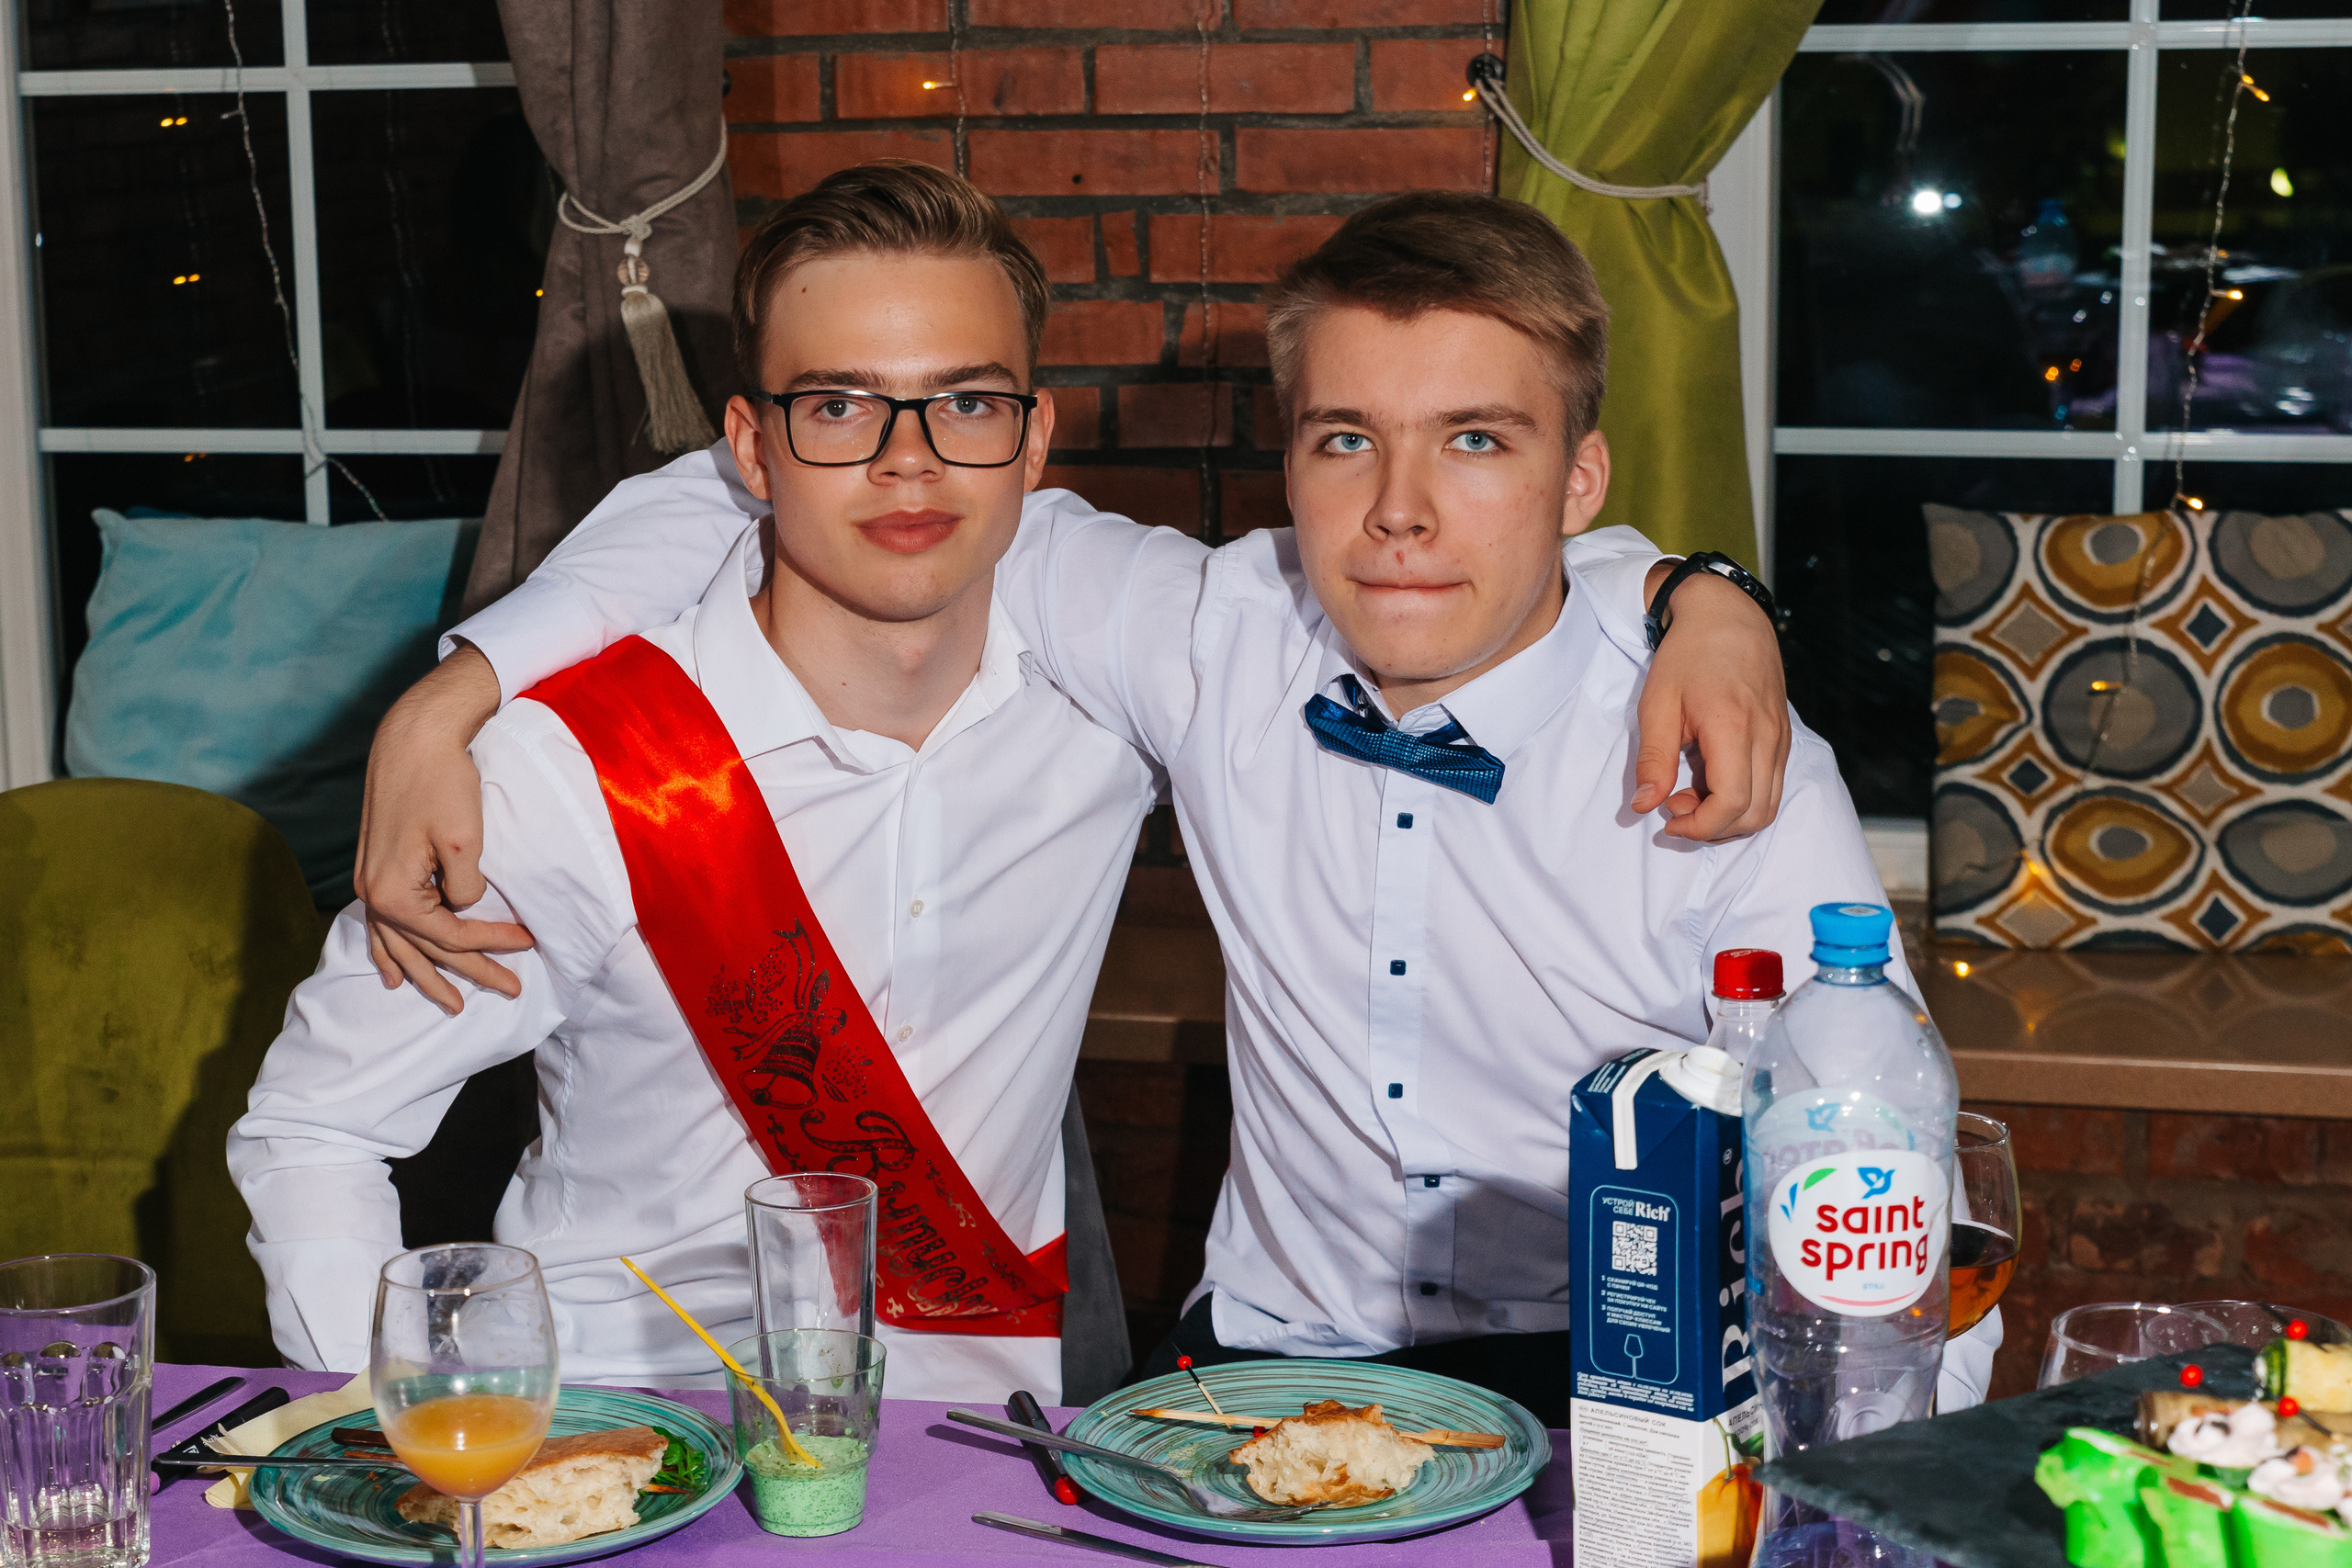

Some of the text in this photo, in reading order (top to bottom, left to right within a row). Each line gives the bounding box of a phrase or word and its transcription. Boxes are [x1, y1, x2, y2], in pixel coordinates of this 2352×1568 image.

[1601, 1197, 1669, 1222] УСТРОЙ Rich
[1612, 1205, 1634, 1216] СЕБЕ
[1815, 1195, 1925, 1235] saint
[1800, 1233, 1929, 1281] spring
[1590, 1407, 1649, 1424] АПЕЛЬСИНОВЫЙ
[1651, 1419, 1667, 1427] СОК
